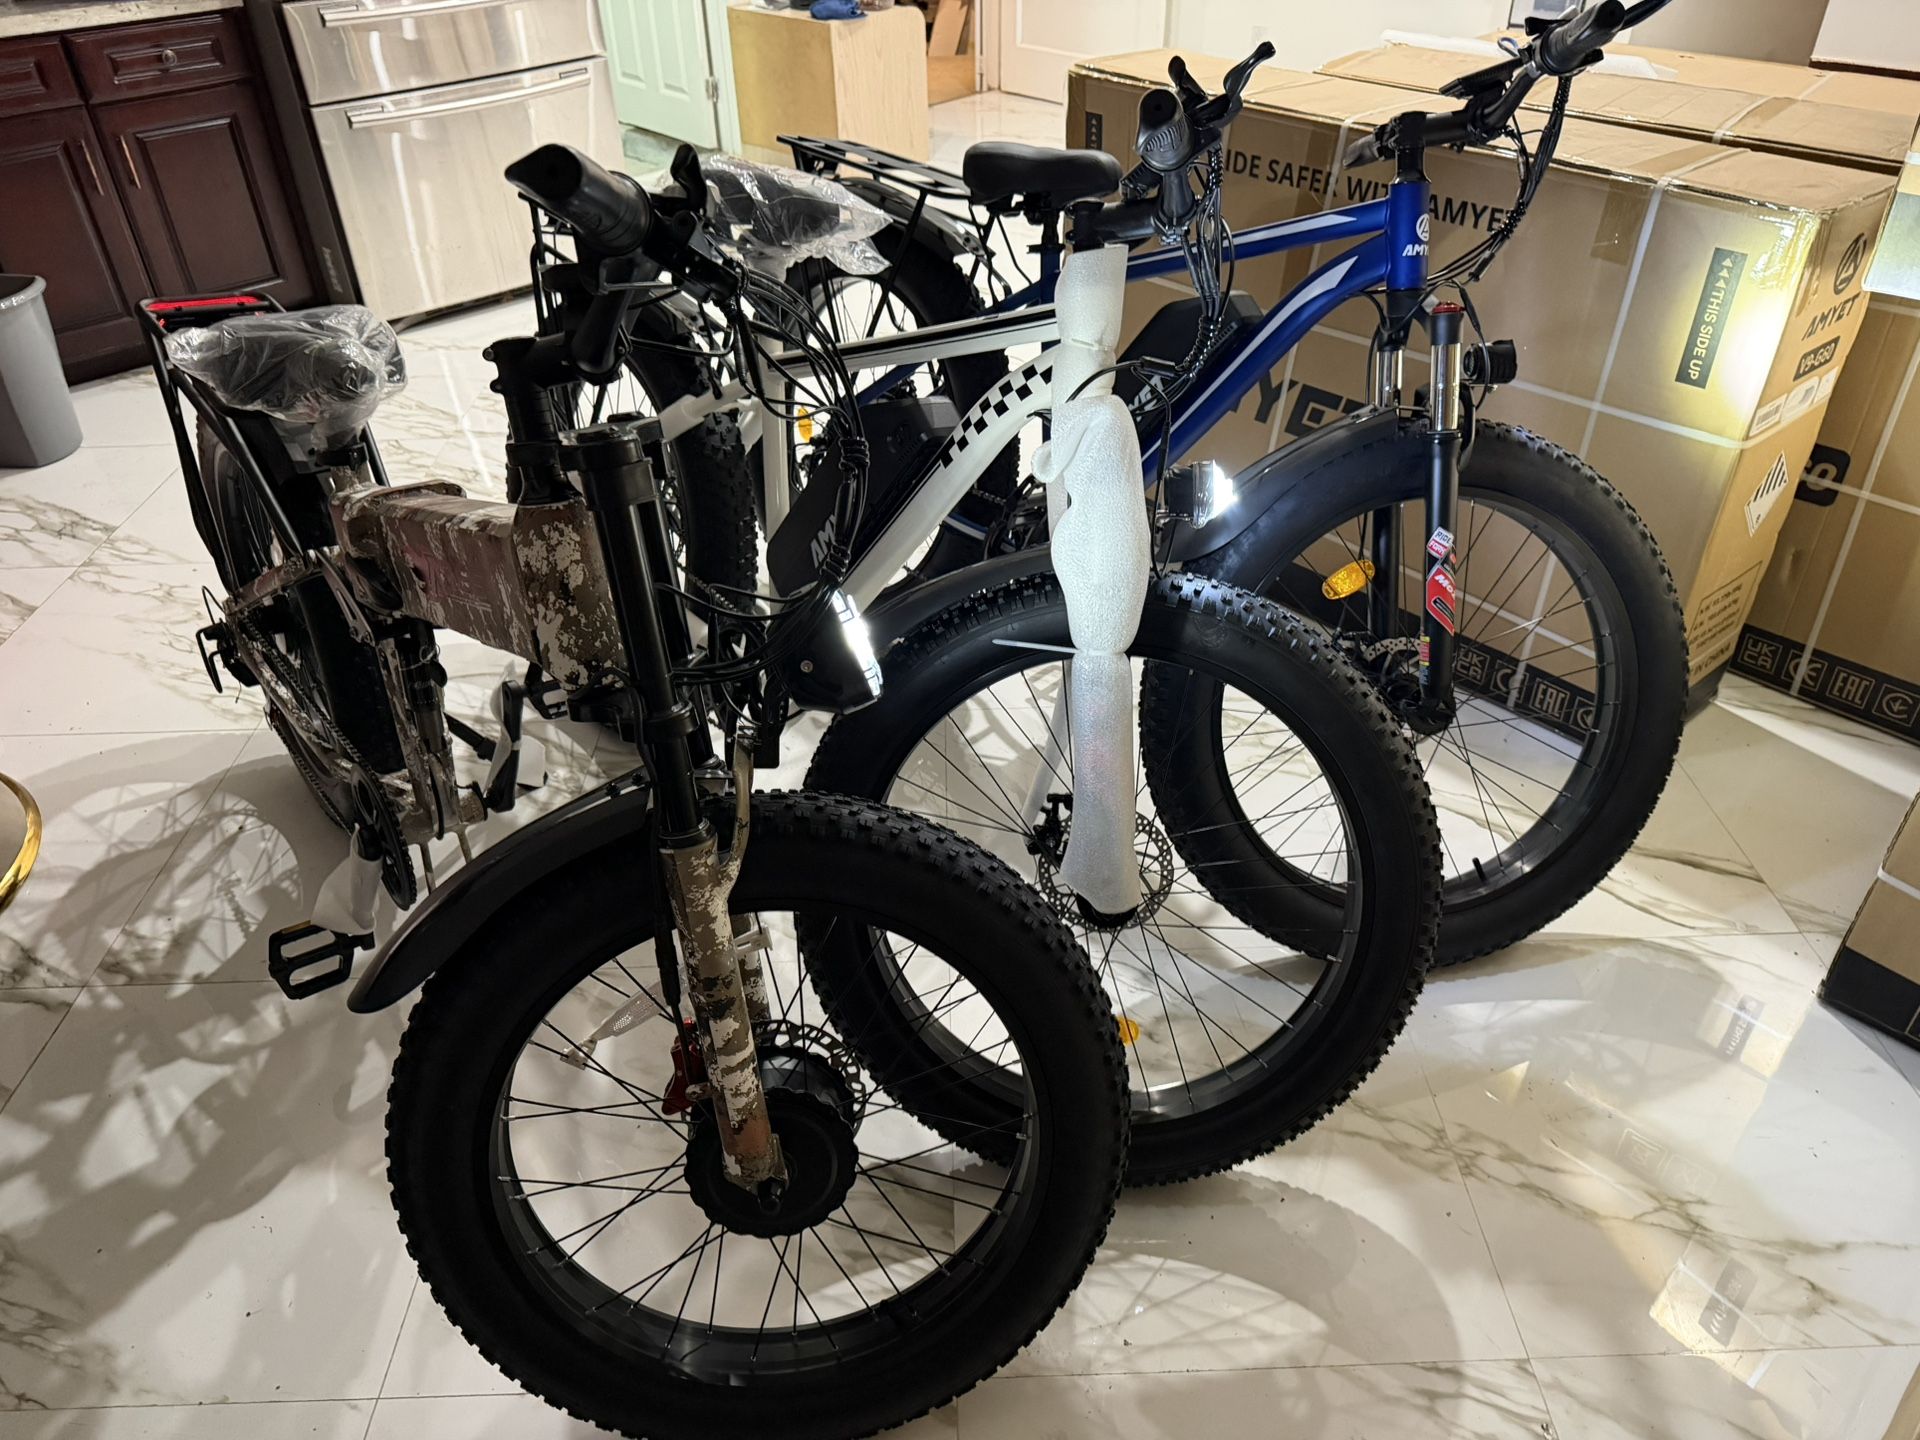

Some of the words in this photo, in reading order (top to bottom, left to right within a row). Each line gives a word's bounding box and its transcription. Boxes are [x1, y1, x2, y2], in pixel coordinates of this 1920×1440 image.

[1225, 149, 1261, 178] IDE
[1347, 176, 1389, 202] WIT
[1429, 194, 1508, 232] AMYE
[1703, 289, 1726, 324] THIS
[1801, 291, 1861, 341] AMYET
[1692, 324, 1713, 358] SIDE
[1687, 360, 1704, 380] UP
[1743, 652, 1773, 670] CA
[1747, 637, 1778, 660] UK
[1534, 683, 1566, 717] EAC
[1834, 670, 1870, 705] EAC
